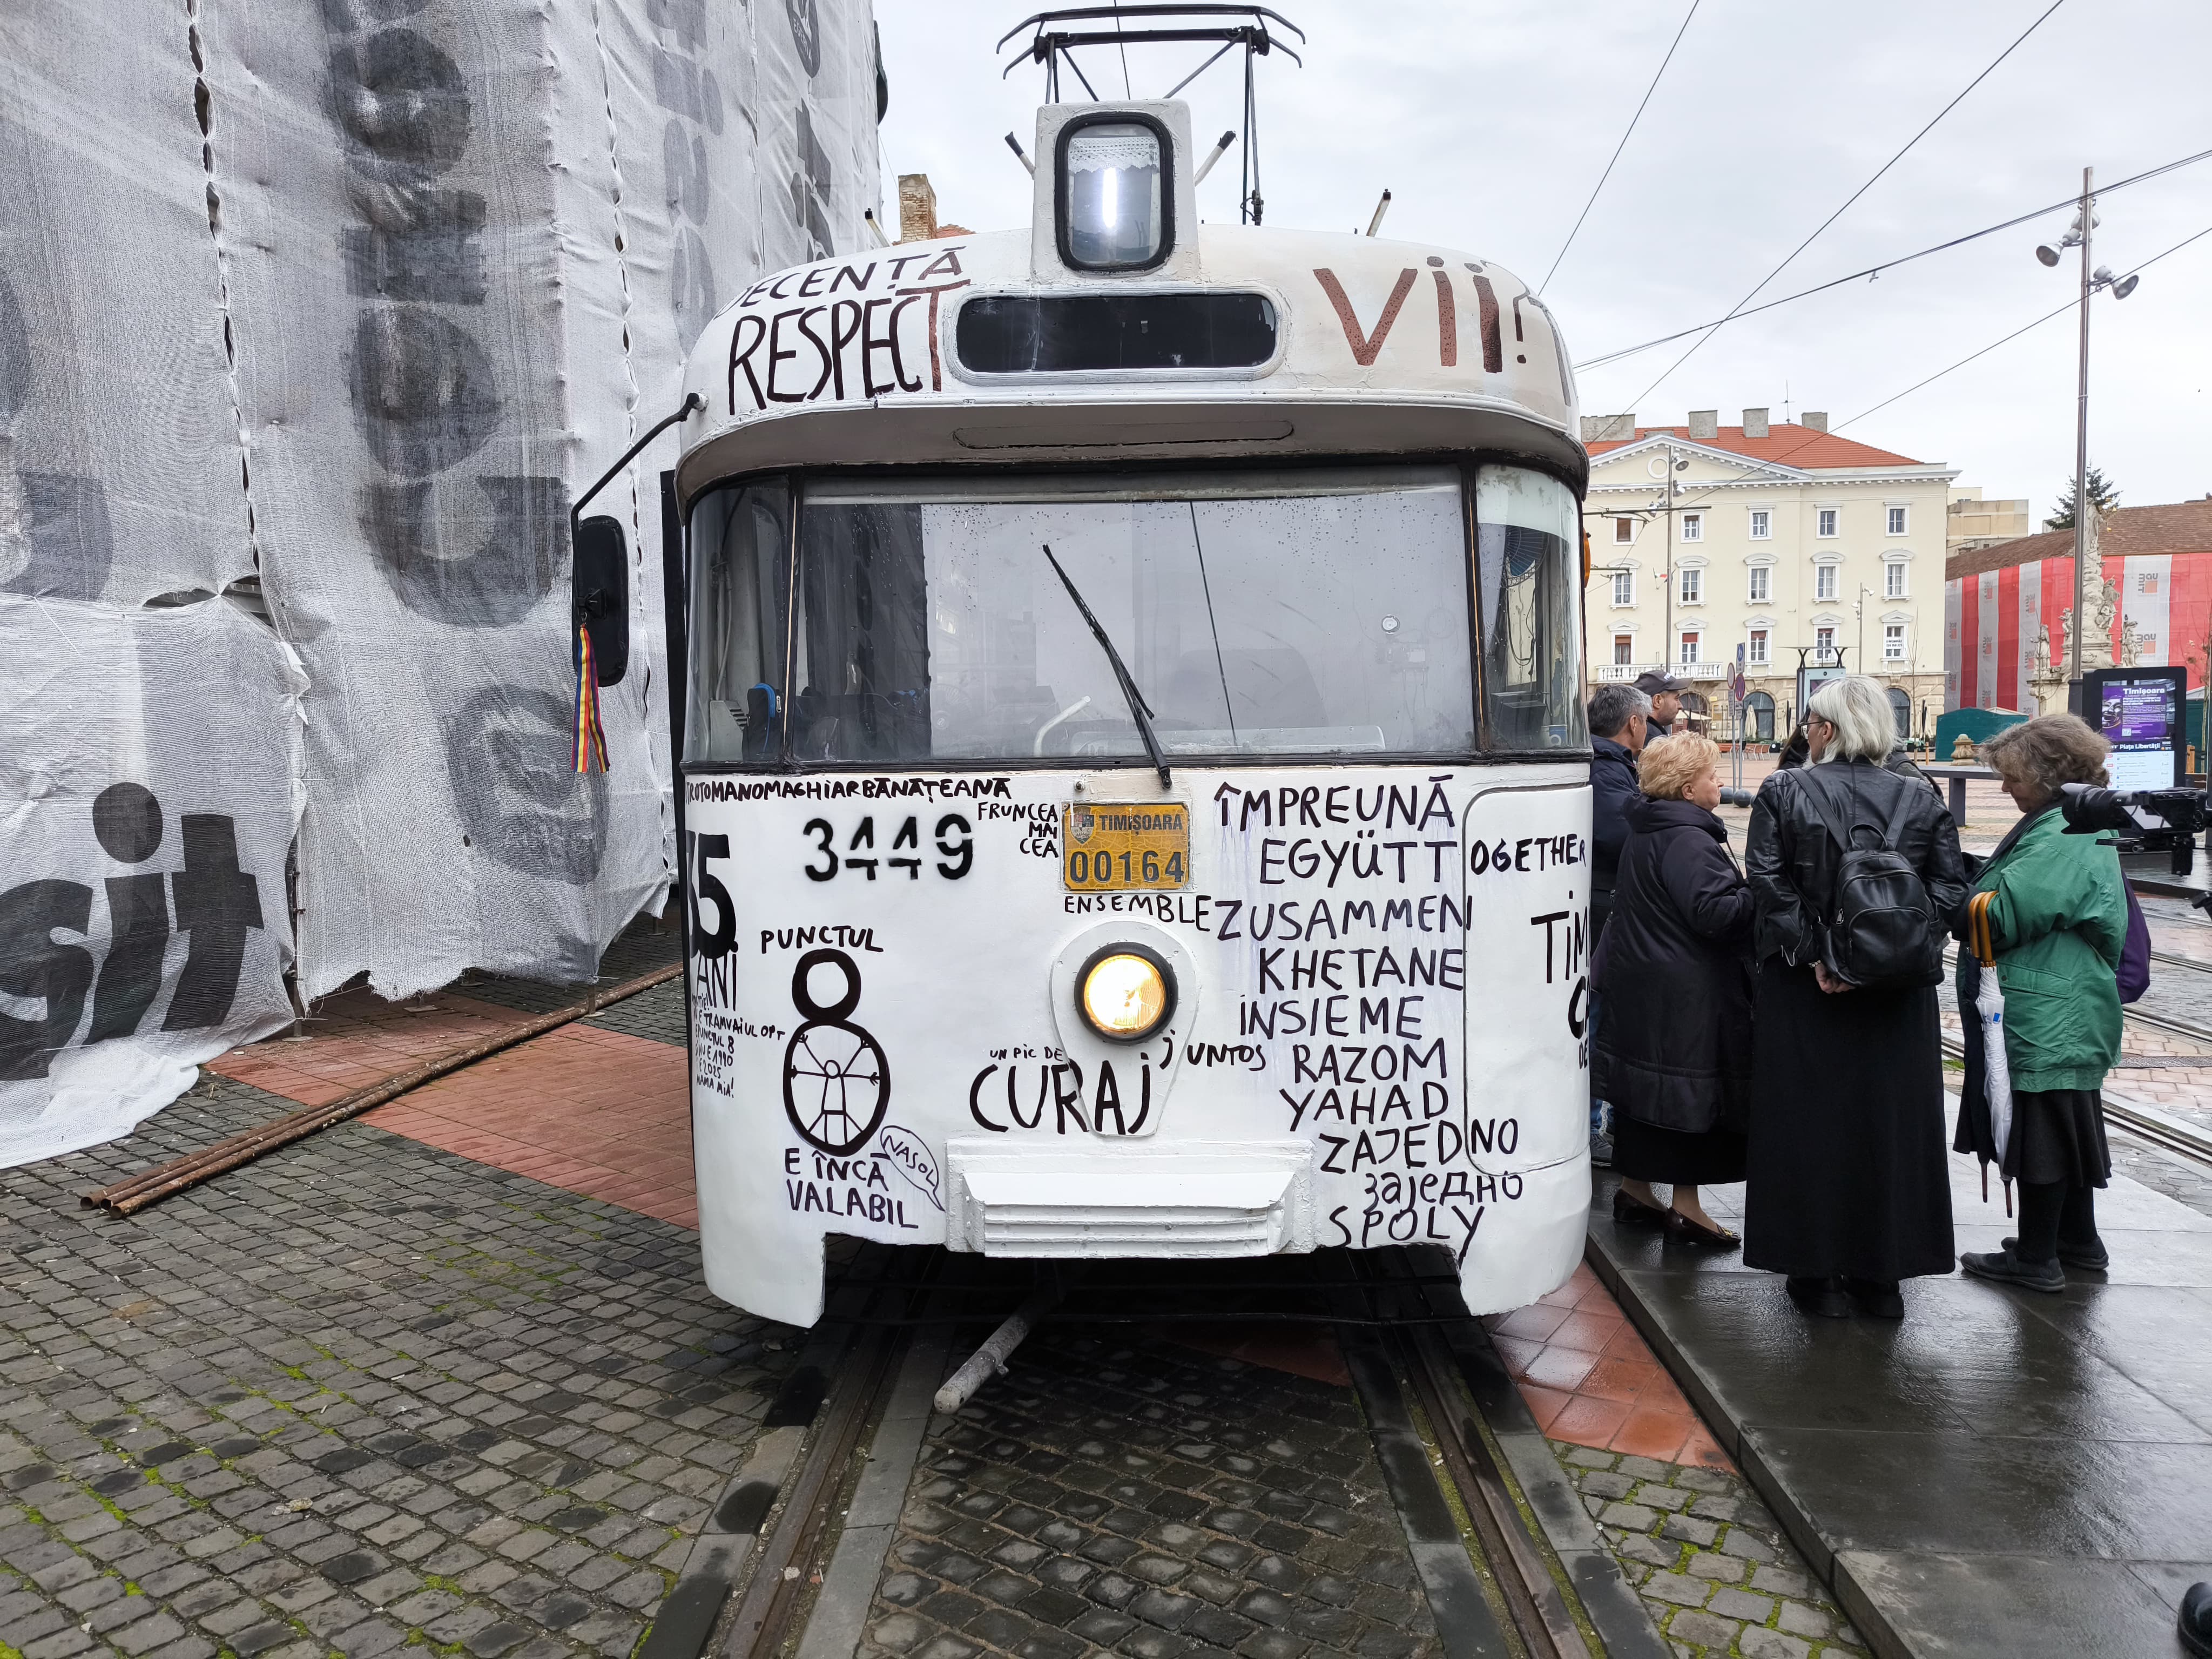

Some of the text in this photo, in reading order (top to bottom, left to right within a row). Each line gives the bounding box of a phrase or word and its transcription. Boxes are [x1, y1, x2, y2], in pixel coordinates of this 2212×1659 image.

[729, 279, 971, 415] RESPECT
[978, 801, 1058, 822] FRUNCEA
[1100, 814, 1183, 835] TIMIȘOARA
[1215, 775, 1455, 831] ÎMPREUNĂ
[1020, 839, 1058, 858] CEA
[1070, 851, 1184, 882] 00164
[1260, 830, 1457, 888] EGYÜTT
[1065, 894, 1211, 932] ENSEMBLE
[1215, 893, 1472, 941] ZUSAMMEN
[761, 925, 884, 953] PUNCTUL
[1259, 946, 1463, 994] KHETANE
[761, 1025, 785, 1040] OPT
[1293, 1037, 1446, 1085] RAZOM
[1279, 1082, 1448, 1131] YAHAD
[785, 1148, 800, 1174] E
[883, 1135, 935, 1186] NASOL
[1319, 1118, 1518, 1174] ZAJEDNO
[786, 1179, 918, 1228] VALABIL
[1330, 1205, 1485, 1269] SPOLY
